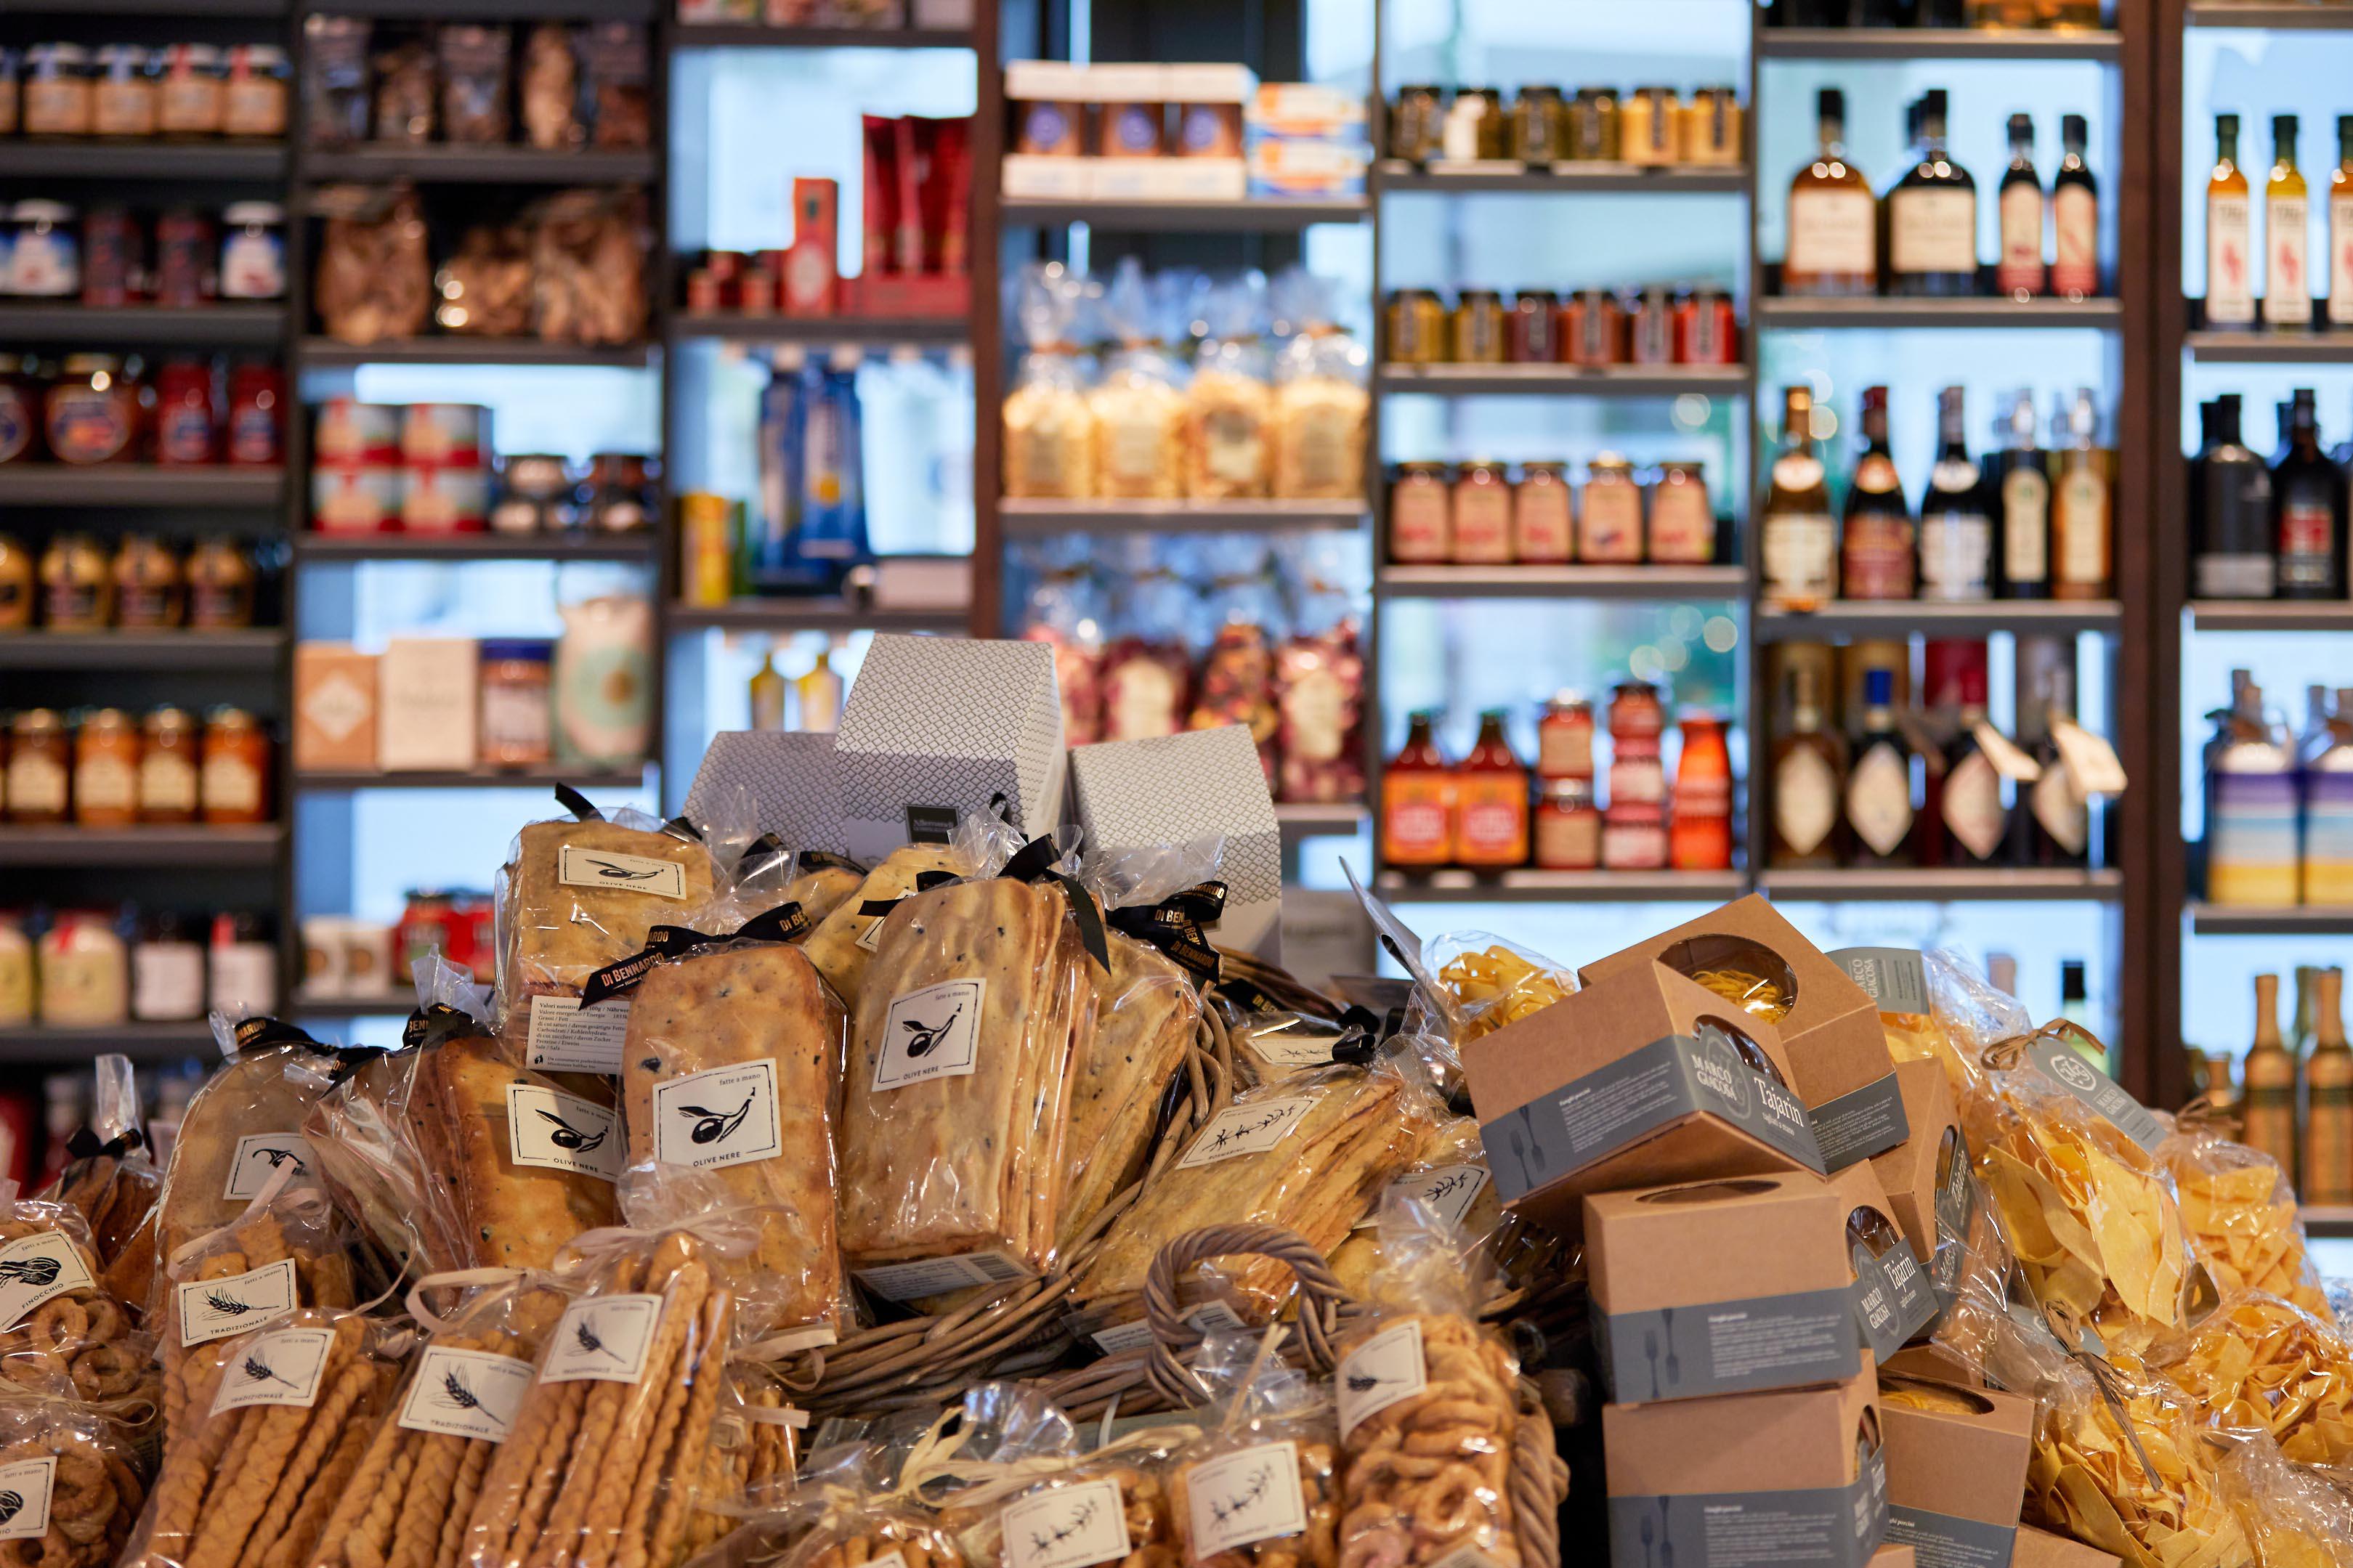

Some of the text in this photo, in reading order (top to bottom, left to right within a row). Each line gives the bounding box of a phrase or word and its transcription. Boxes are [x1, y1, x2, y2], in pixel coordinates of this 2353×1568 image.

[779, 919, 792, 932] DI
[601, 974, 613, 987] DI
[612, 952, 665, 983] BENNARDO
[1853, 959, 1866, 994] ARCO
[1864, 958, 1879, 999] GIACOSA
[903, 1065, 939, 1080] OLIVE NERE
[1691, 1054, 1733, 1084] MARCO
[719, 1077, 734, 1086] fatte
[1754, 1076, 1805, 1128] Tajarin
[554, 1157, 599, 1173] OLIVE NERE
[693, 1151, 741, 1168] OLIVE NERE
[22, 1243, 35, 1251] fatti
[244, 1277, 258, 1285] fatti
[264, 1269, 282, 1277] mano
[1884, 1252, 1916, 1293] Tajarin
[22, 1283, 64, 1309] FINOCCHIO
[1861, 1288, 1883, 1315] MARCO
[210, 1315, 268, 1335] TRADIZIONALE
[231, 1392, 284, 1403] TRADIZIONALE
[430, 1419, 490, 1435] TRADIZIONALE
